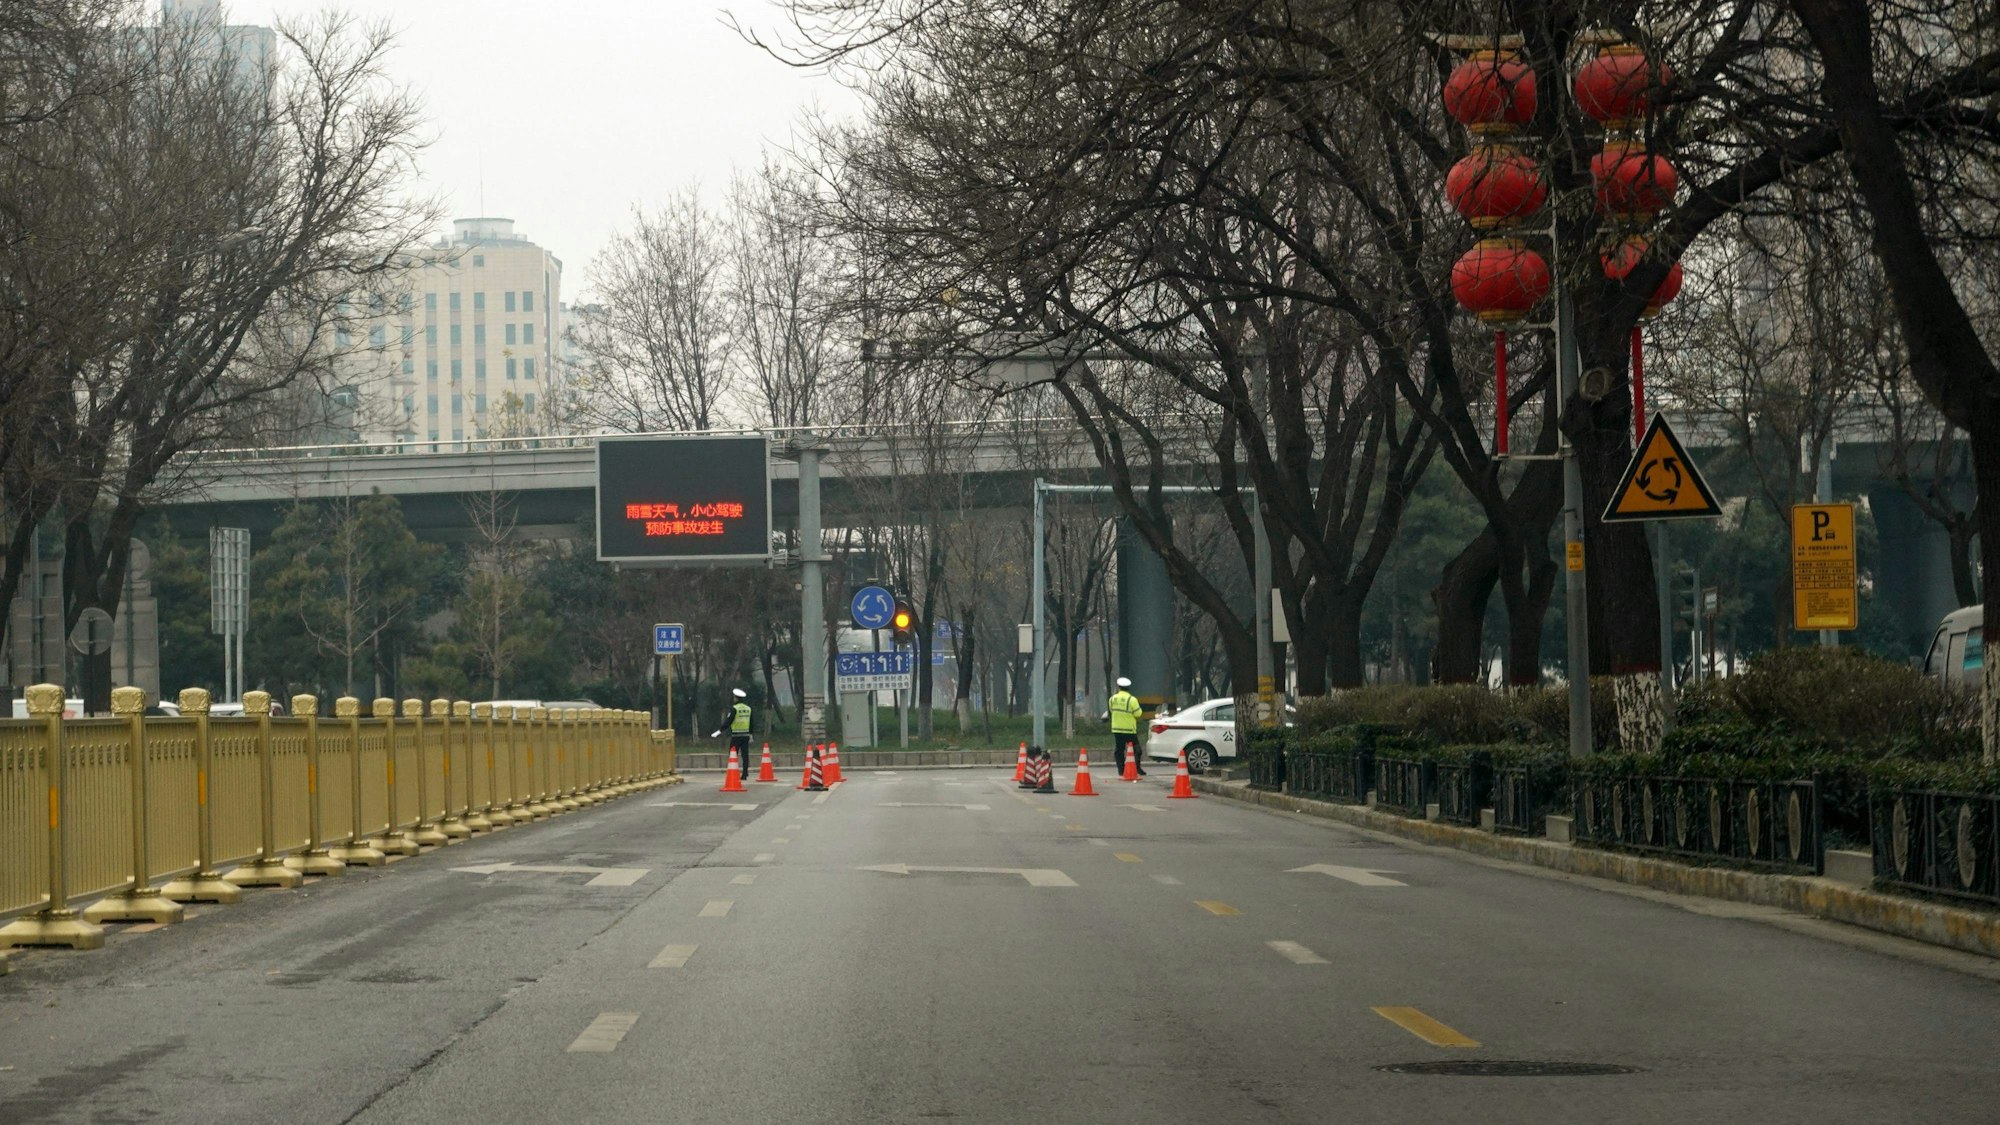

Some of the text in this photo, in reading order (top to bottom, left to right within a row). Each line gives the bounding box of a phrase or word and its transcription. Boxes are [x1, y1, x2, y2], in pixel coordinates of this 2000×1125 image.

[646, 521, 724, 535] 预防事故发生
[1811, 511, 1830, 541] P
[1222, 731, 1234, 742] 公
